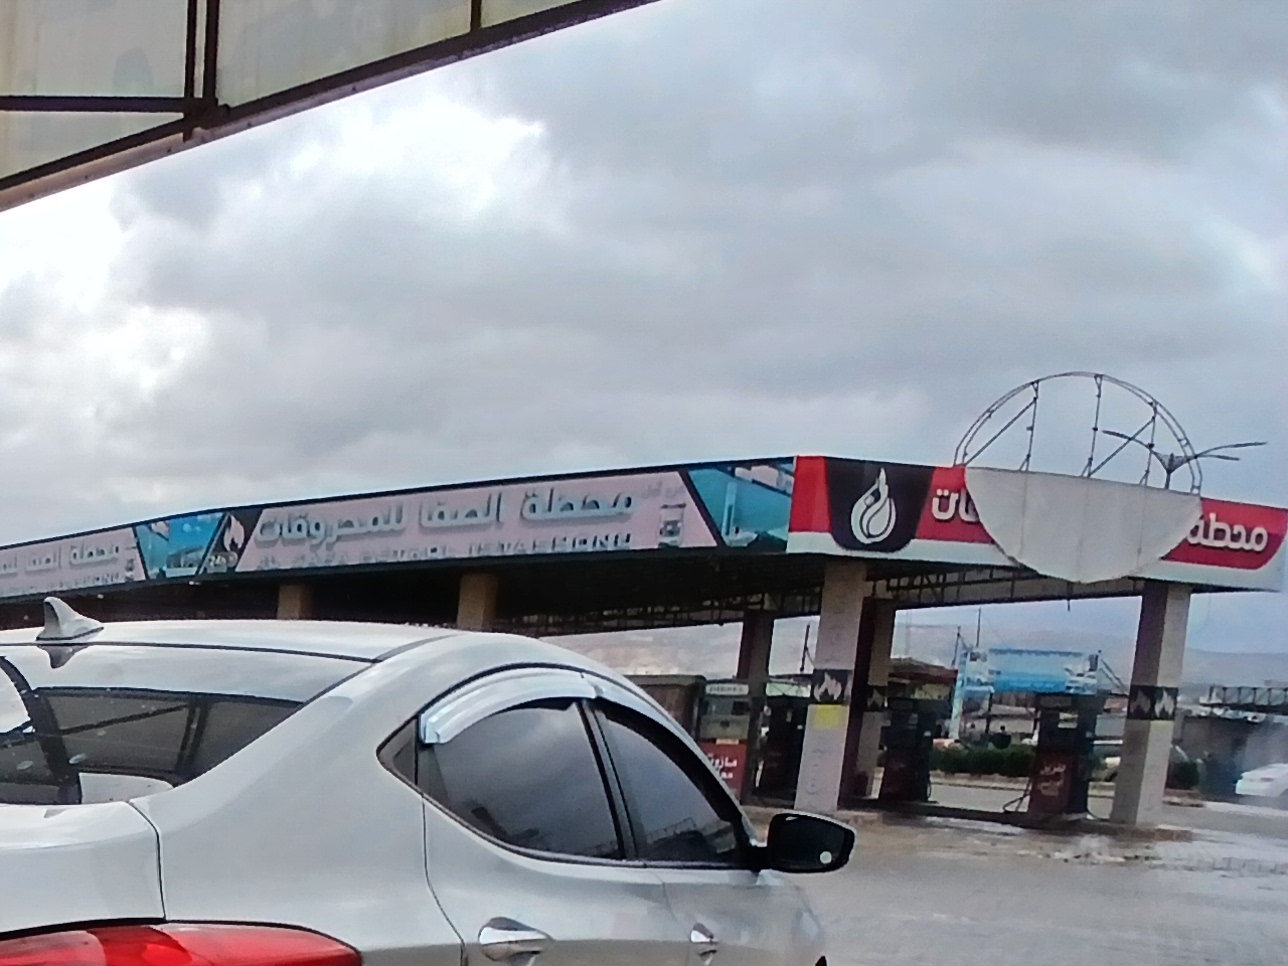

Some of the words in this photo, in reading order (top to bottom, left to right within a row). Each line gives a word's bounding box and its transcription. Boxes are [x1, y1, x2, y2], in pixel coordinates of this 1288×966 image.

[253, 504, 406, 549] للمحروقات
[419, 491, 503, 531] الصفا
[520, 488, 634, 526] محطة
